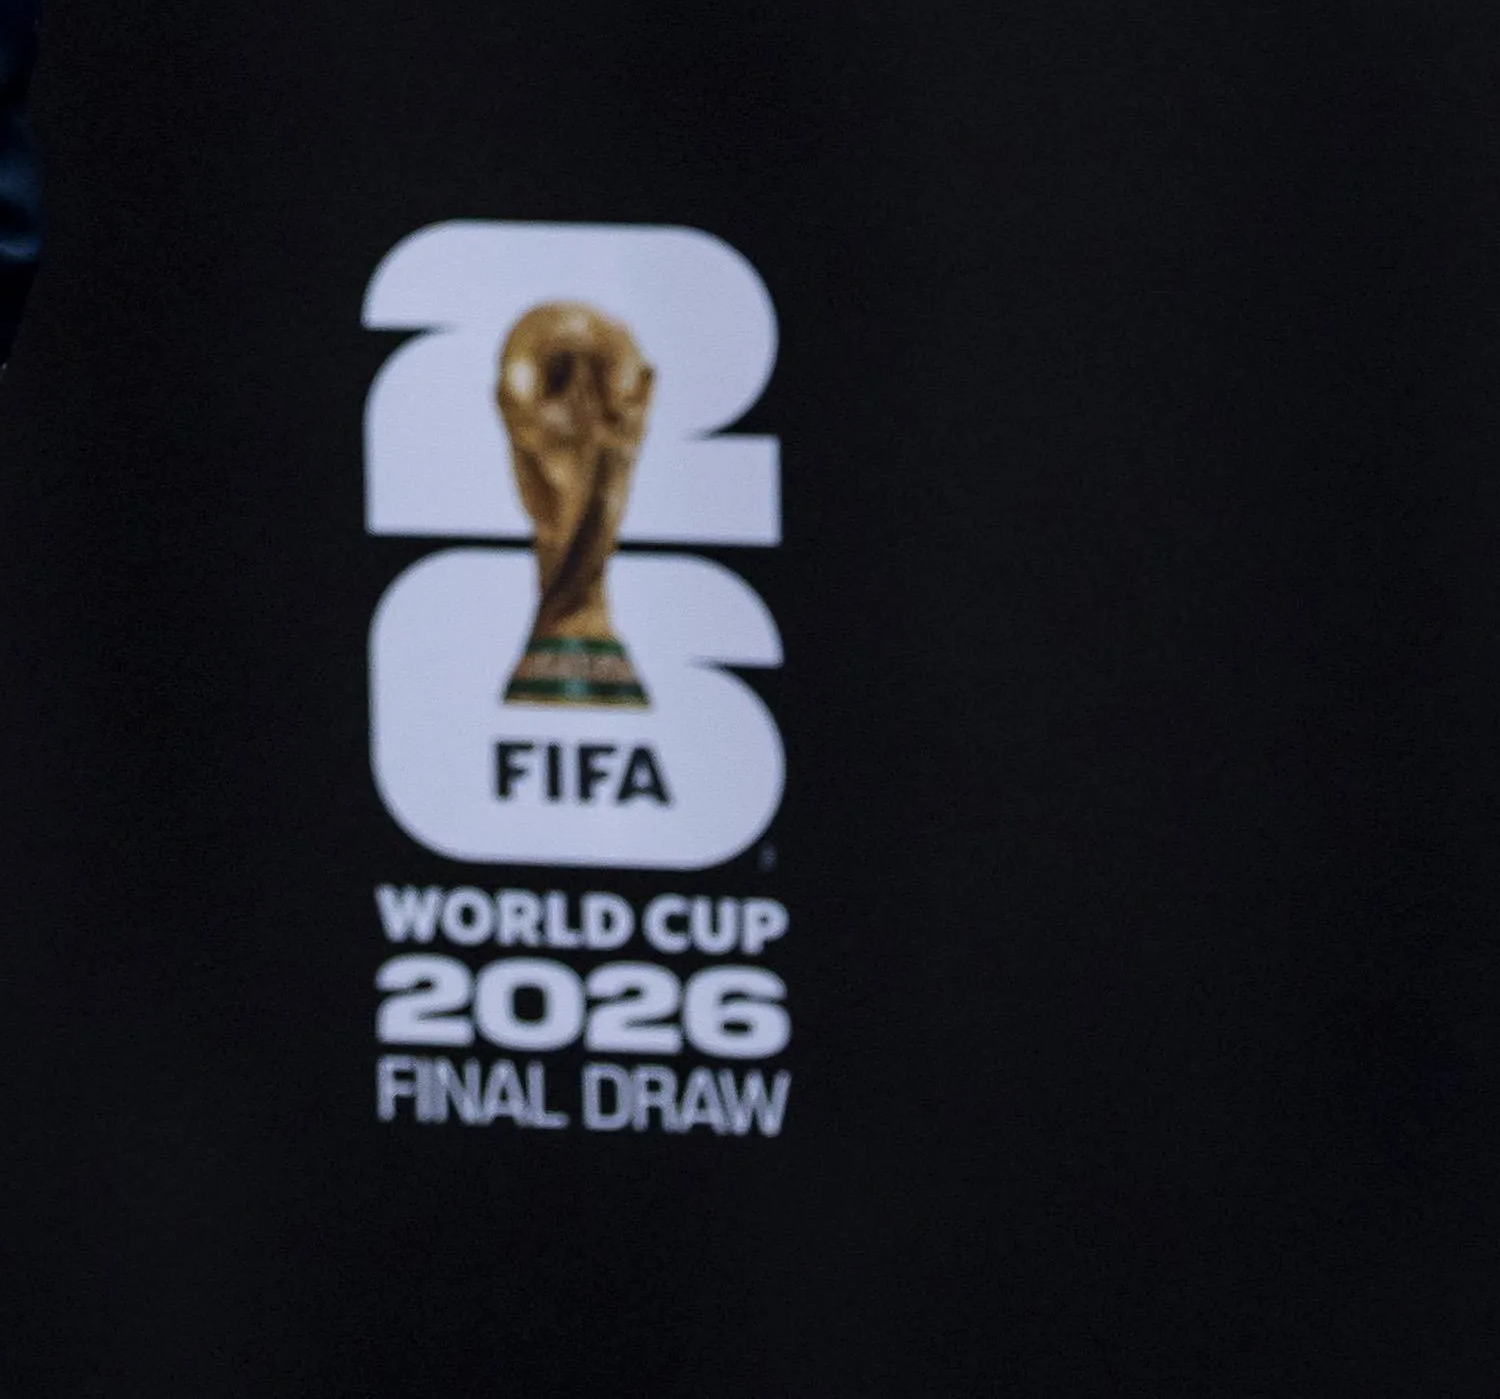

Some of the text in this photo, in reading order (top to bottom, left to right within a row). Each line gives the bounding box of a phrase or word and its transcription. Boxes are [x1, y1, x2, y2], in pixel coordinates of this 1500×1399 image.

[493, 739, 672, 807] FIFA
[375, 884, 790, 955] WORLD CUP
[375, 954, 791, 1059] 2026
[376, 1054, 793, 1137] FINAL DRAW
